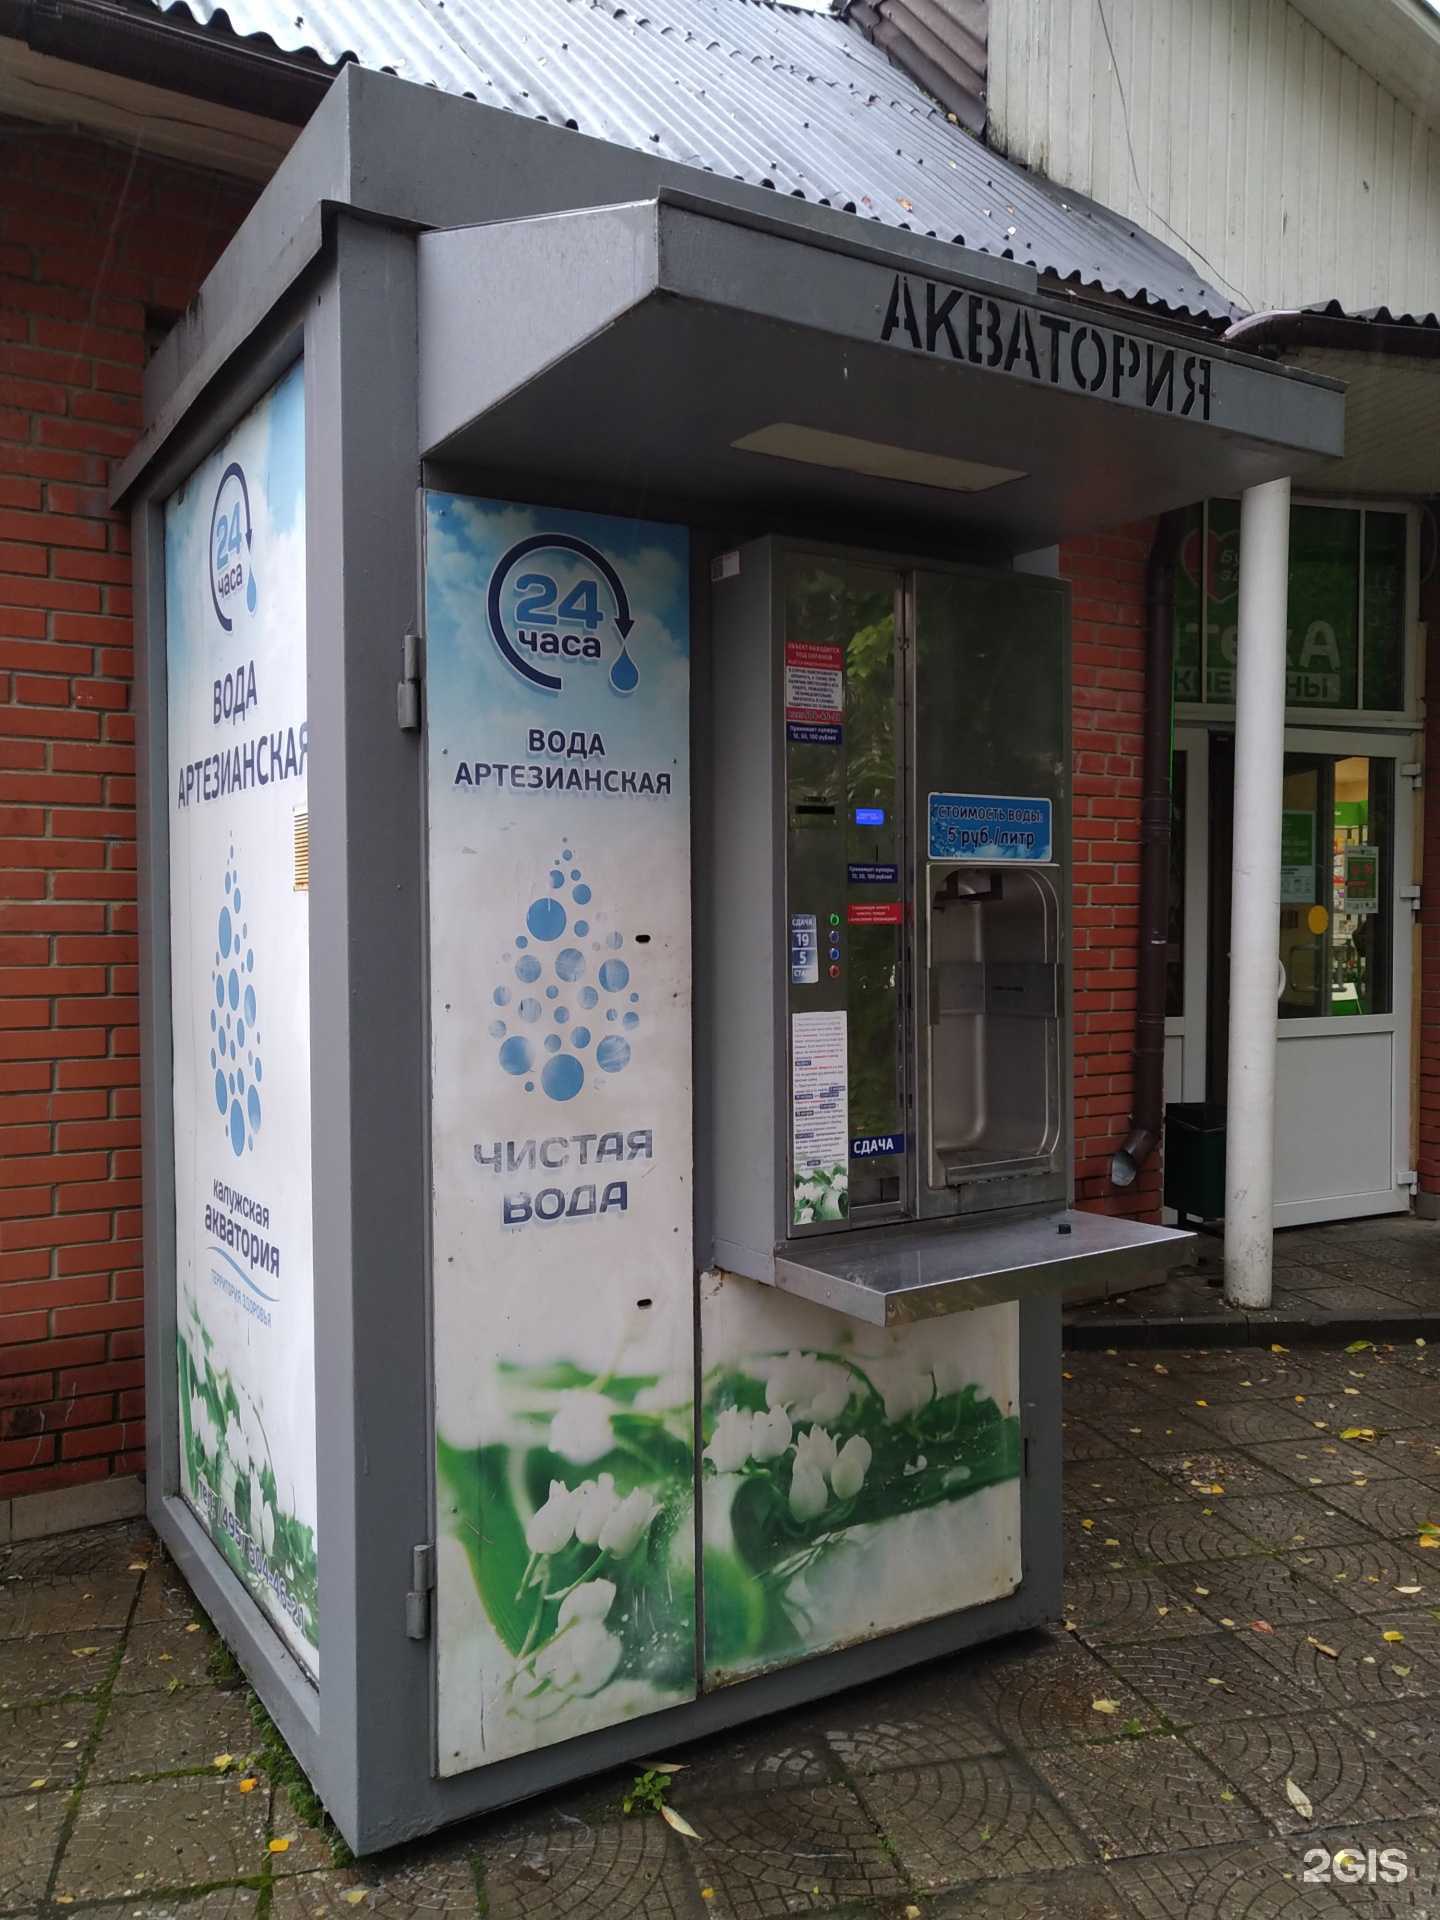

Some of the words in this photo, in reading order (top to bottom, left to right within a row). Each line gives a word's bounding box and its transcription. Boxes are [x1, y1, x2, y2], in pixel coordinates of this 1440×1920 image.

[880, 273, 1212, 421] АКВАТОРИЯ
[216, 500, 242, 572] 24
[218, 562, 243, 598] часа
[513, 572, 604, 630] 24
[518, 630, 601, 659] часа
[213, 660, 257, 726] ВОДА
[178, 720, 310, 809] АРТЕЗИАНСКАЯ
[527, 728, 607, 761] ВОДА
[454, 761, 672, 796] АРТЕЗИАНСКАЯ
[938, 805, 1006, 821] СТОИМОСТЬ
[948, 826, 956, 842] 5
[796, 933, 809, 947] 19
[799, 951, 807, 965] 5
[473, 1129, 653, 1174] ЧИСТАЯ
[853, 1137, 895, 1156] СДАЧА
[213, 1178, 270, 1230] калужская
[502, 1181, 629, 1225] ВОДА
[204, 1204, 280, 1279] акватория
